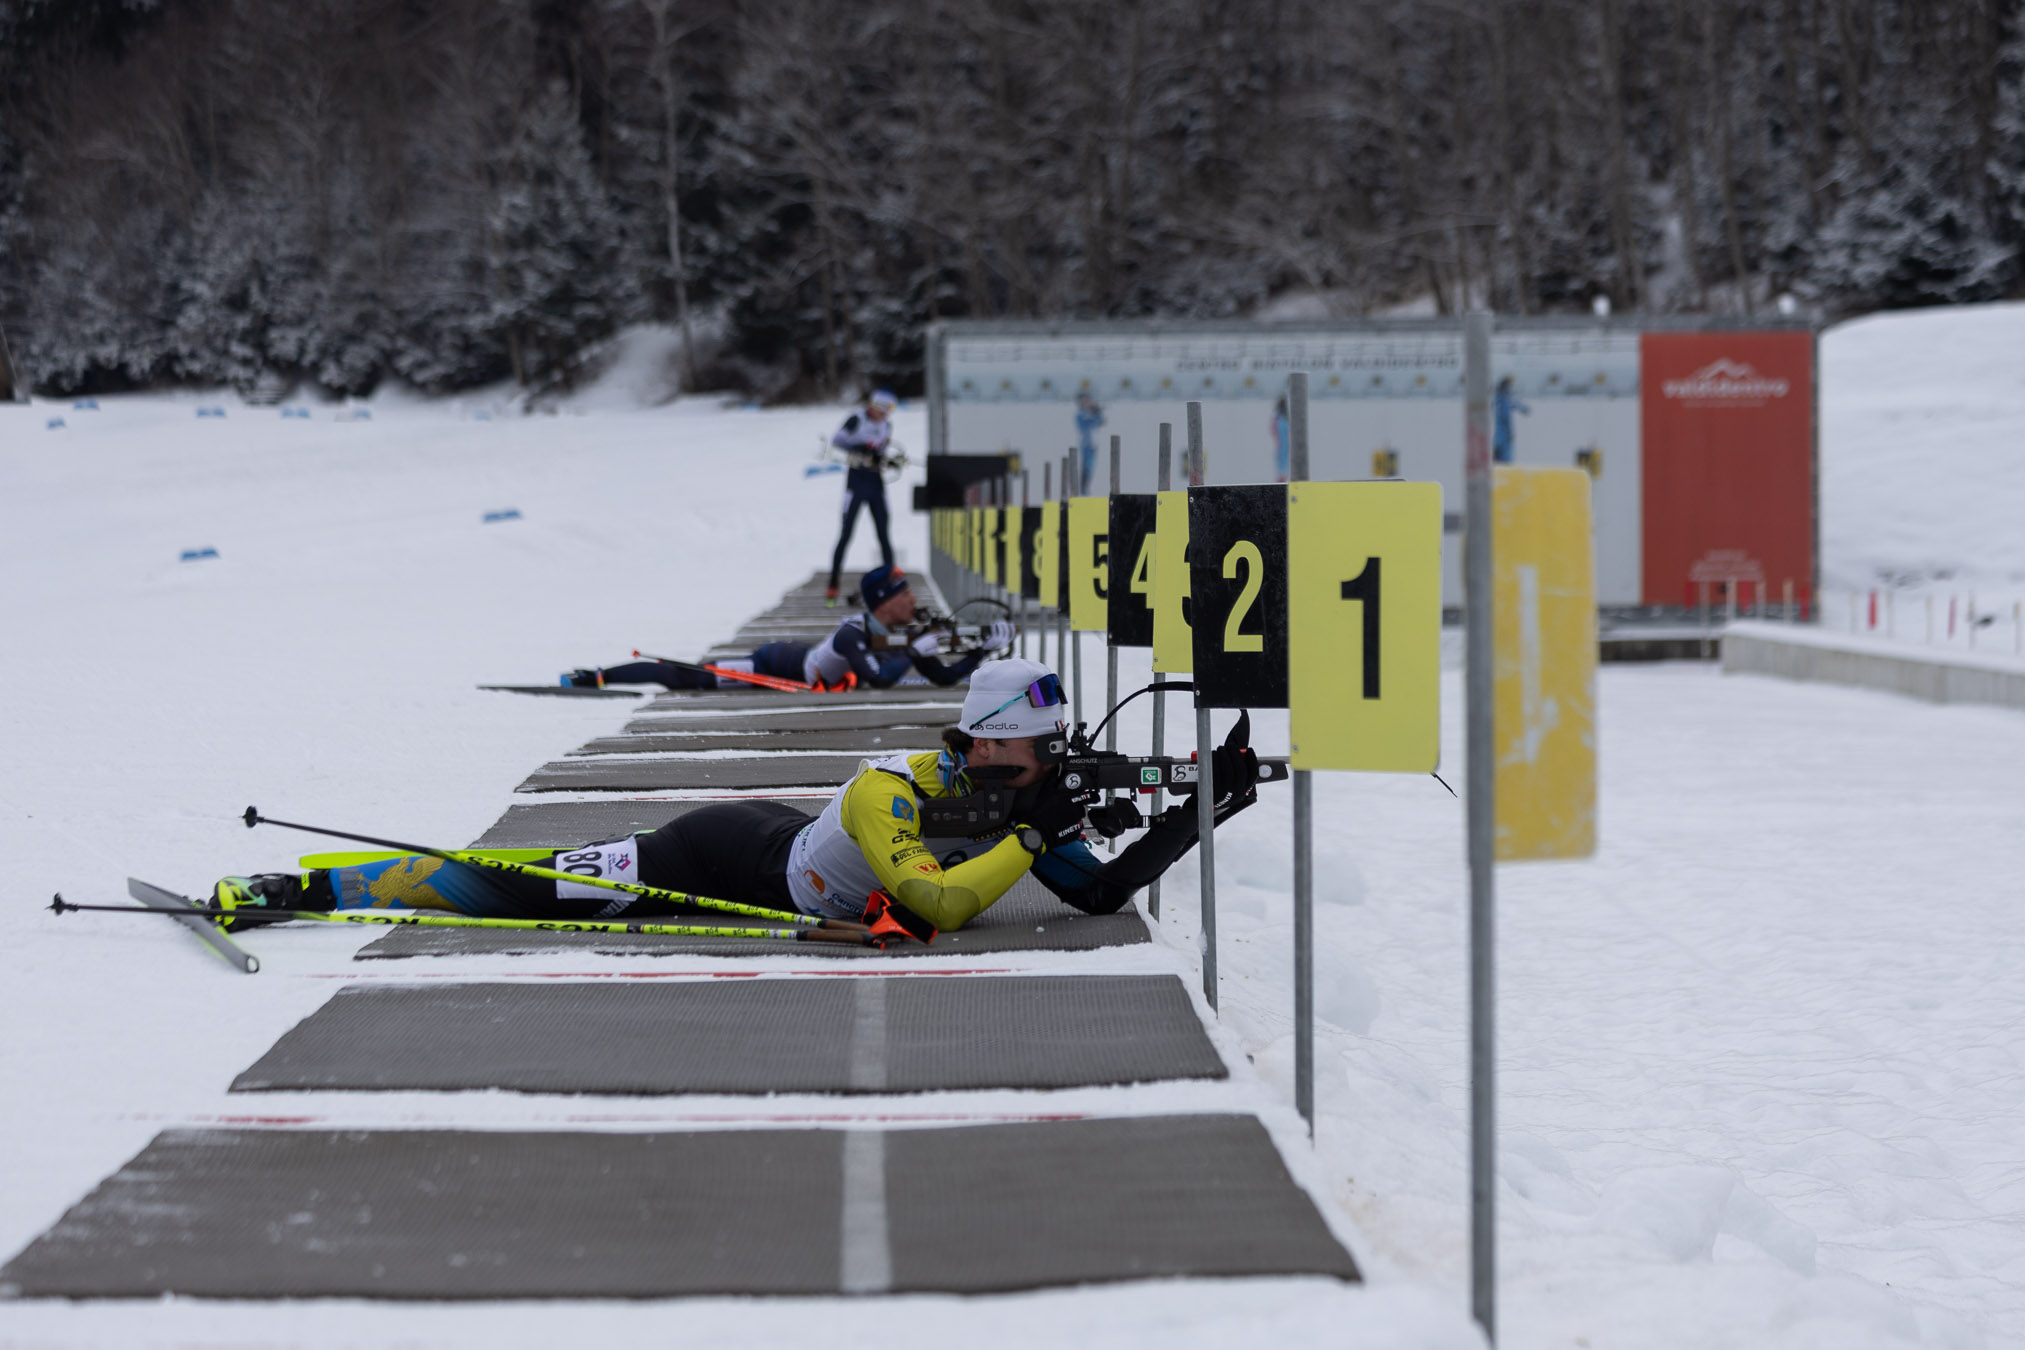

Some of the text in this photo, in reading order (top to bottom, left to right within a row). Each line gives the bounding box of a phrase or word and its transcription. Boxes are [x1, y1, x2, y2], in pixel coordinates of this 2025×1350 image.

[1093, 534, 1108, 600] 5
[1130, 533, 1156, 609] 4
[1222, 540, 1264, 652] 2
[1340, 556, 1381, 699] 1
